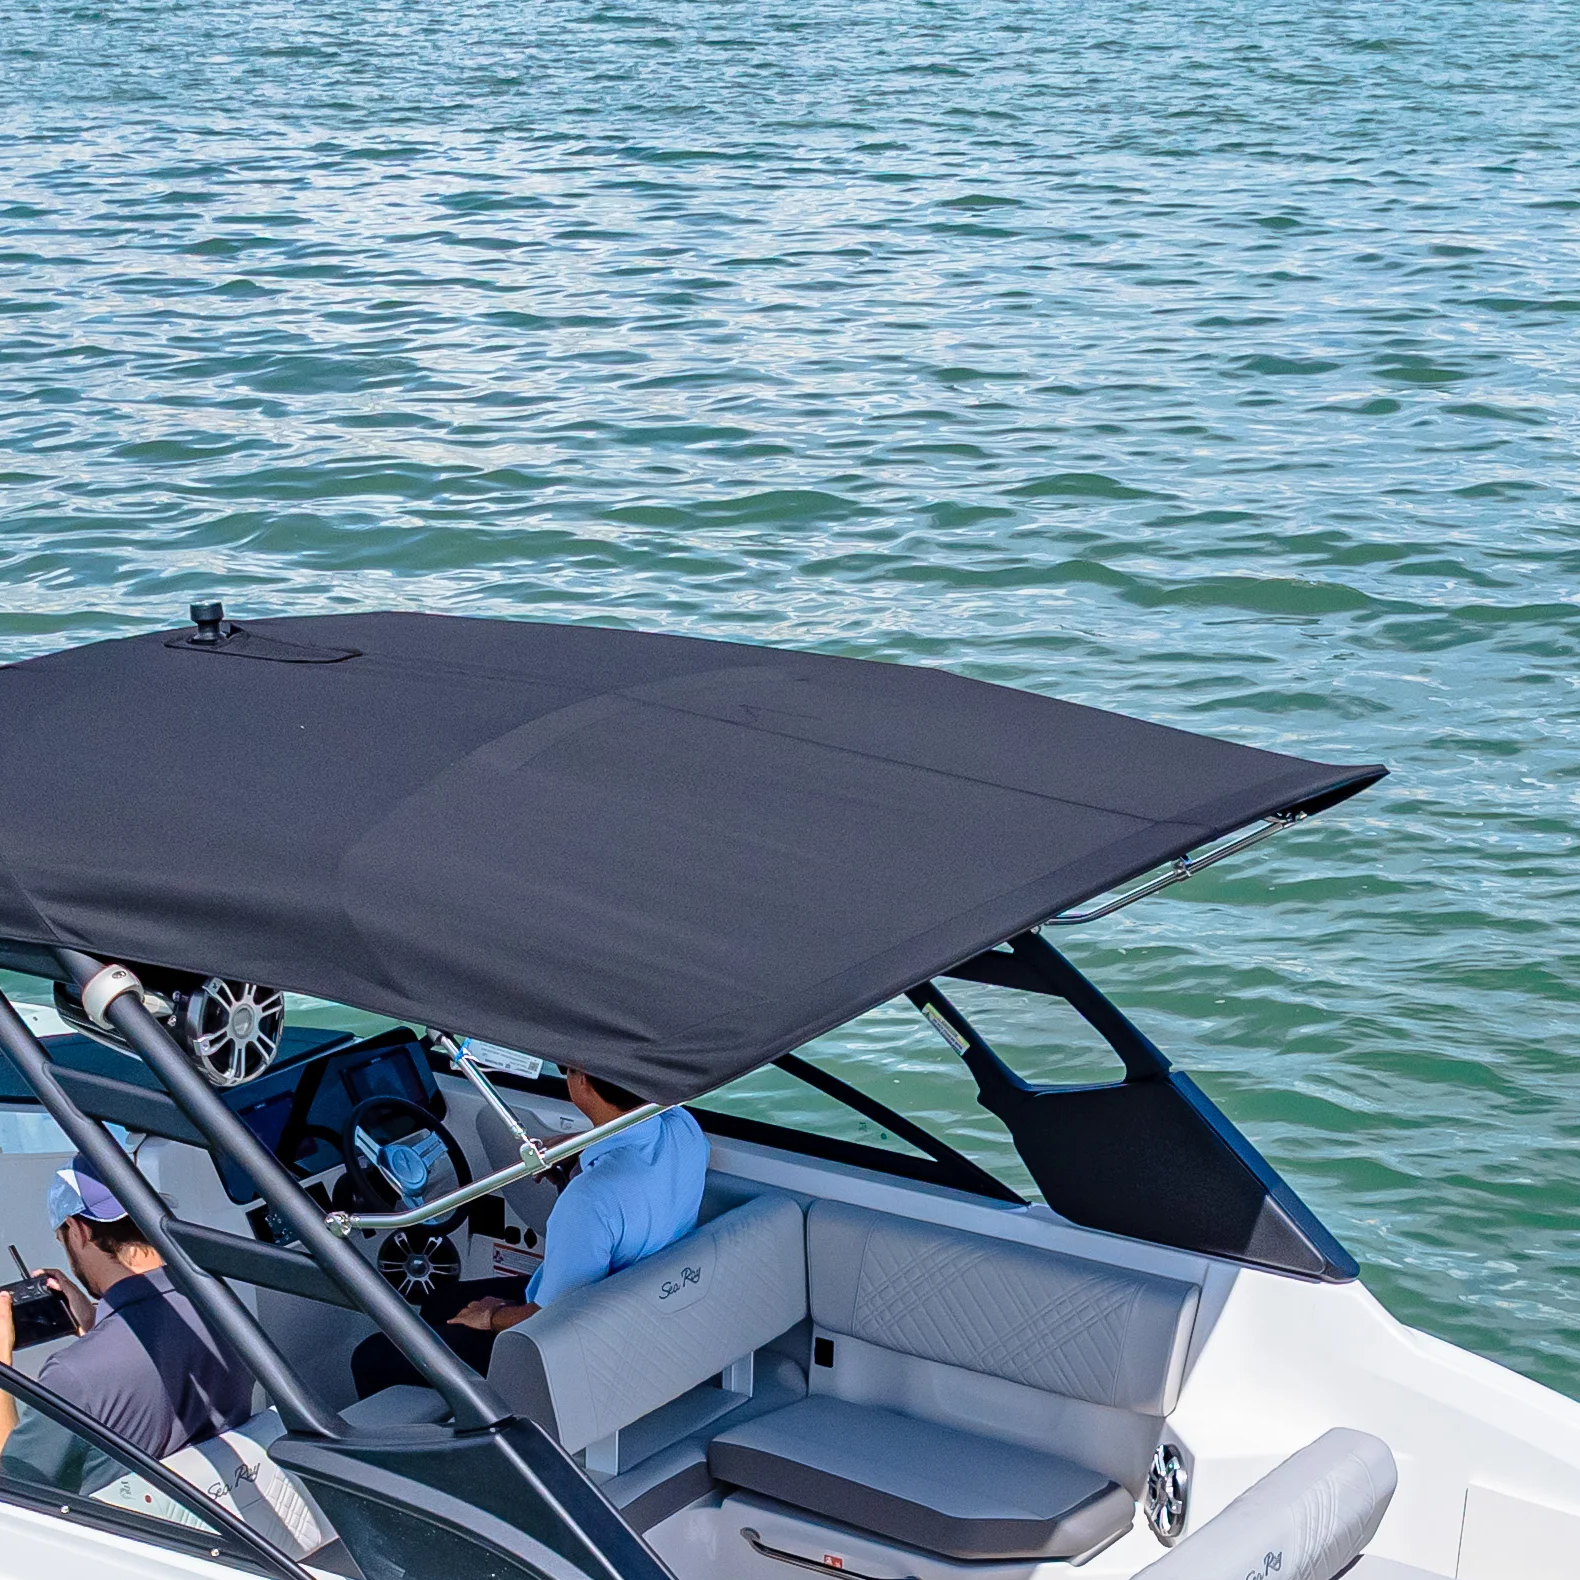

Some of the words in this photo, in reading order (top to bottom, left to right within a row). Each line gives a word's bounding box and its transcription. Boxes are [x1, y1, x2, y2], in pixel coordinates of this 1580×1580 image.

[659, 1281, 681, 1300] Sea
[680, 1266, 702, 1288] Ray
[207, 1481, 233, 1501] Sea
[234, 1462, 261, 1488] Ray
[1263, 1551, 1283, 1577] Ray
